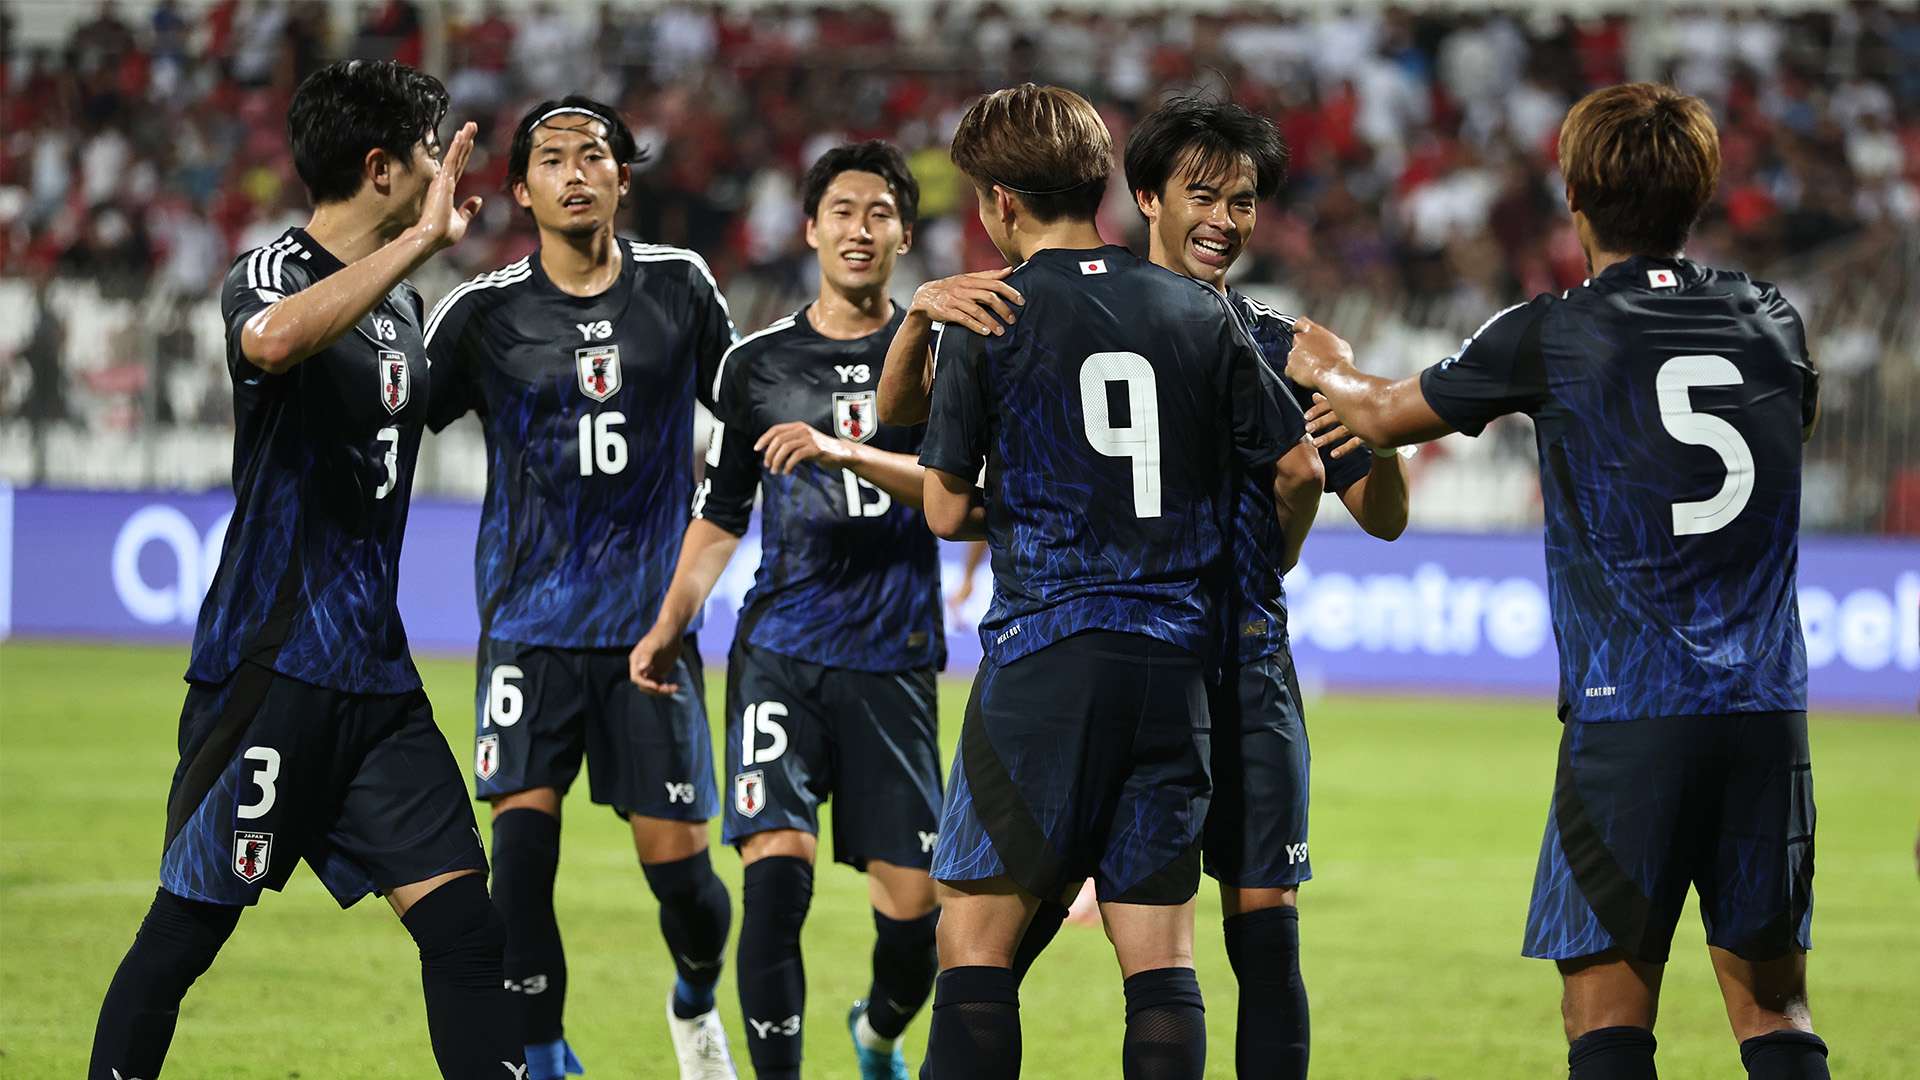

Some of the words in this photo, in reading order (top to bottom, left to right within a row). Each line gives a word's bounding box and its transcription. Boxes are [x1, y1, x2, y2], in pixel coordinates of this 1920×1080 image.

[375, 427, 399, 499] 3
[578, 410, 628, 476] 16
[1079, 351, 1162, 518] 9
[1656, 355, 1755, 536] 5
[742, 700, 789, 767] 15
[237, 746, 280, 819] 3
